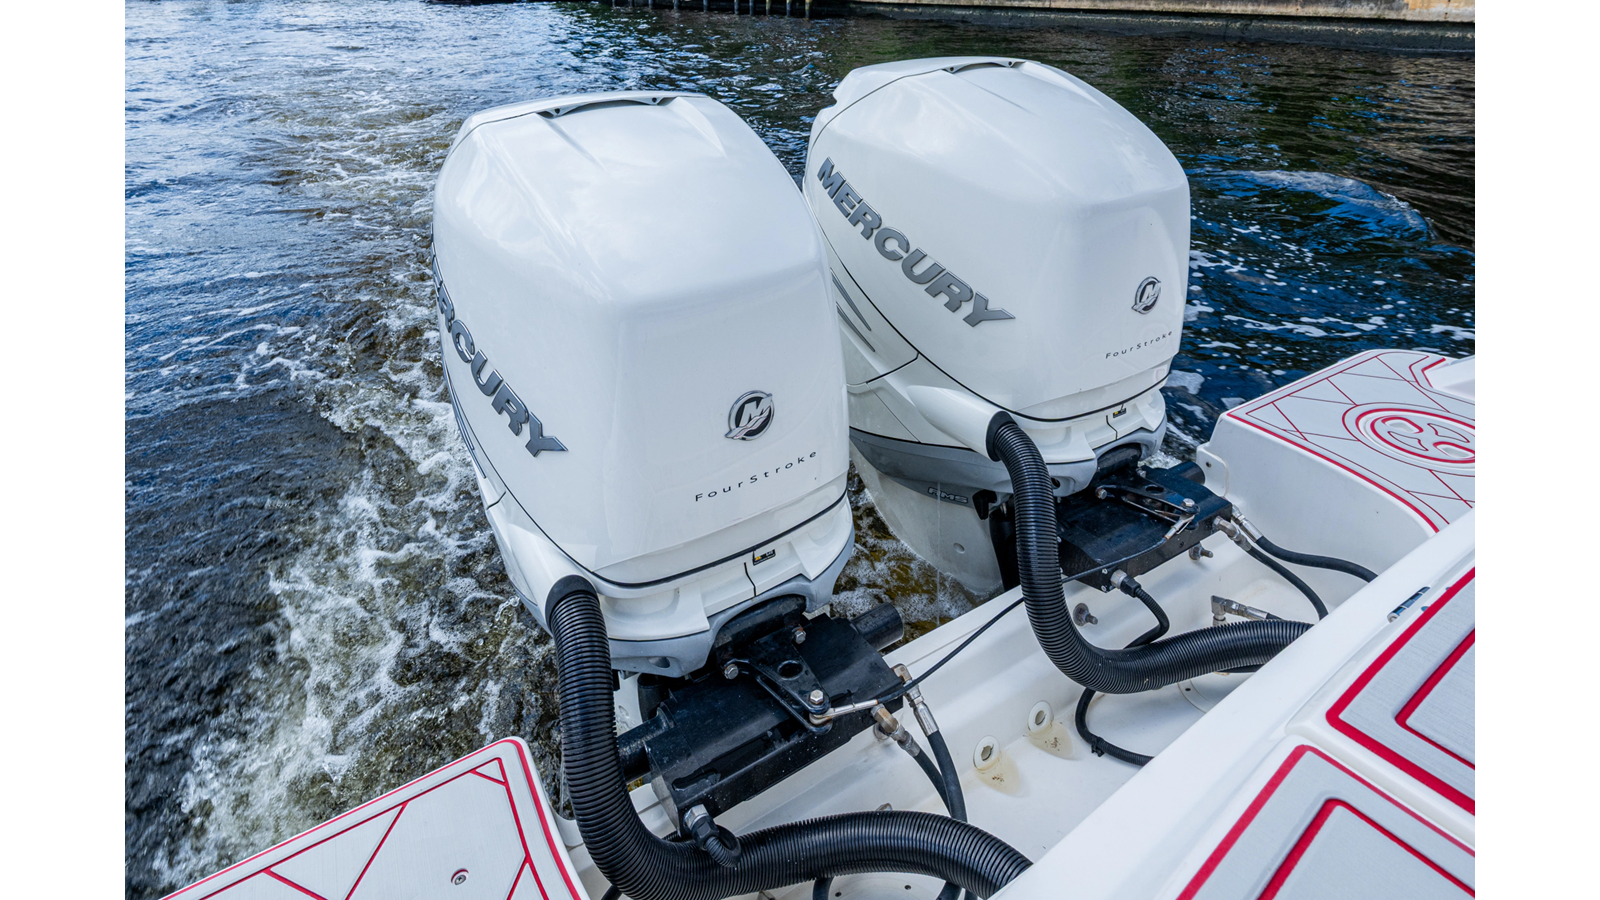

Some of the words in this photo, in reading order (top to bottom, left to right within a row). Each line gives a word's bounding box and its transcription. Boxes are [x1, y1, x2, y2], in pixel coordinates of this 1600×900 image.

[817, 156, 1016, 327] MERCURY
[1105, 331, 1173, 359] FourStroke
[695, 451, 817, 501] FourStroke
